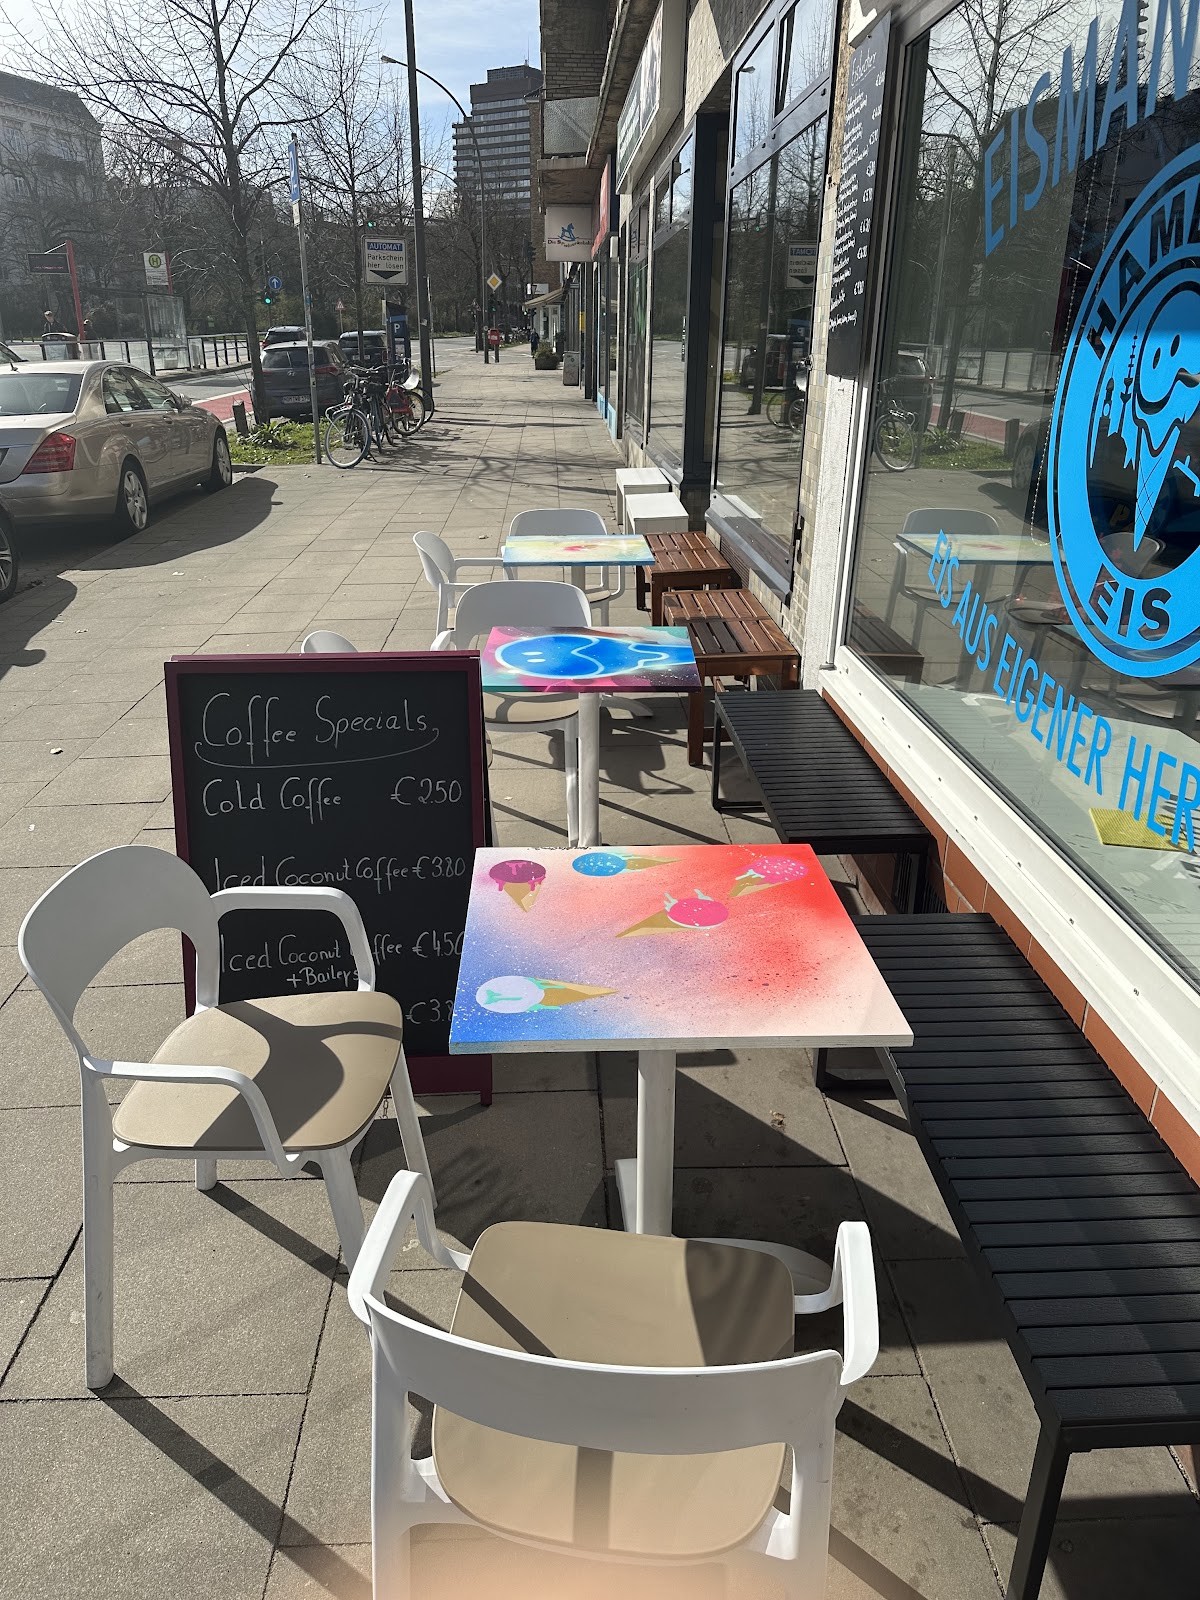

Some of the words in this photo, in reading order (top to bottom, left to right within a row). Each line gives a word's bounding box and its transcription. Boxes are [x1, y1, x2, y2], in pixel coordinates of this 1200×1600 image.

[367, 253, 404, 261] Parkschein
[369, 243, 401, 251] AUTOMAT
[393, 323, 400, 333] P
[1089, 564, 1173, 643] EIS
[927, 529, 960, 610] EIS
[951, 580, 998, 672] AUS
[993, 632, 1112, 795] EIGENER
[202, 692, 298, 764] Coffee
[202, 778, 266, 817] Cold
[279, 777, 342, 824] Coffee
[213, 855, 266, 892] Iced
[275, 856, 352, 887] Coconut
[355, 856, 409, 894] Coffee
[220, 934, 272, 973] Iced
[278, 934, 341, 965] Coconut
